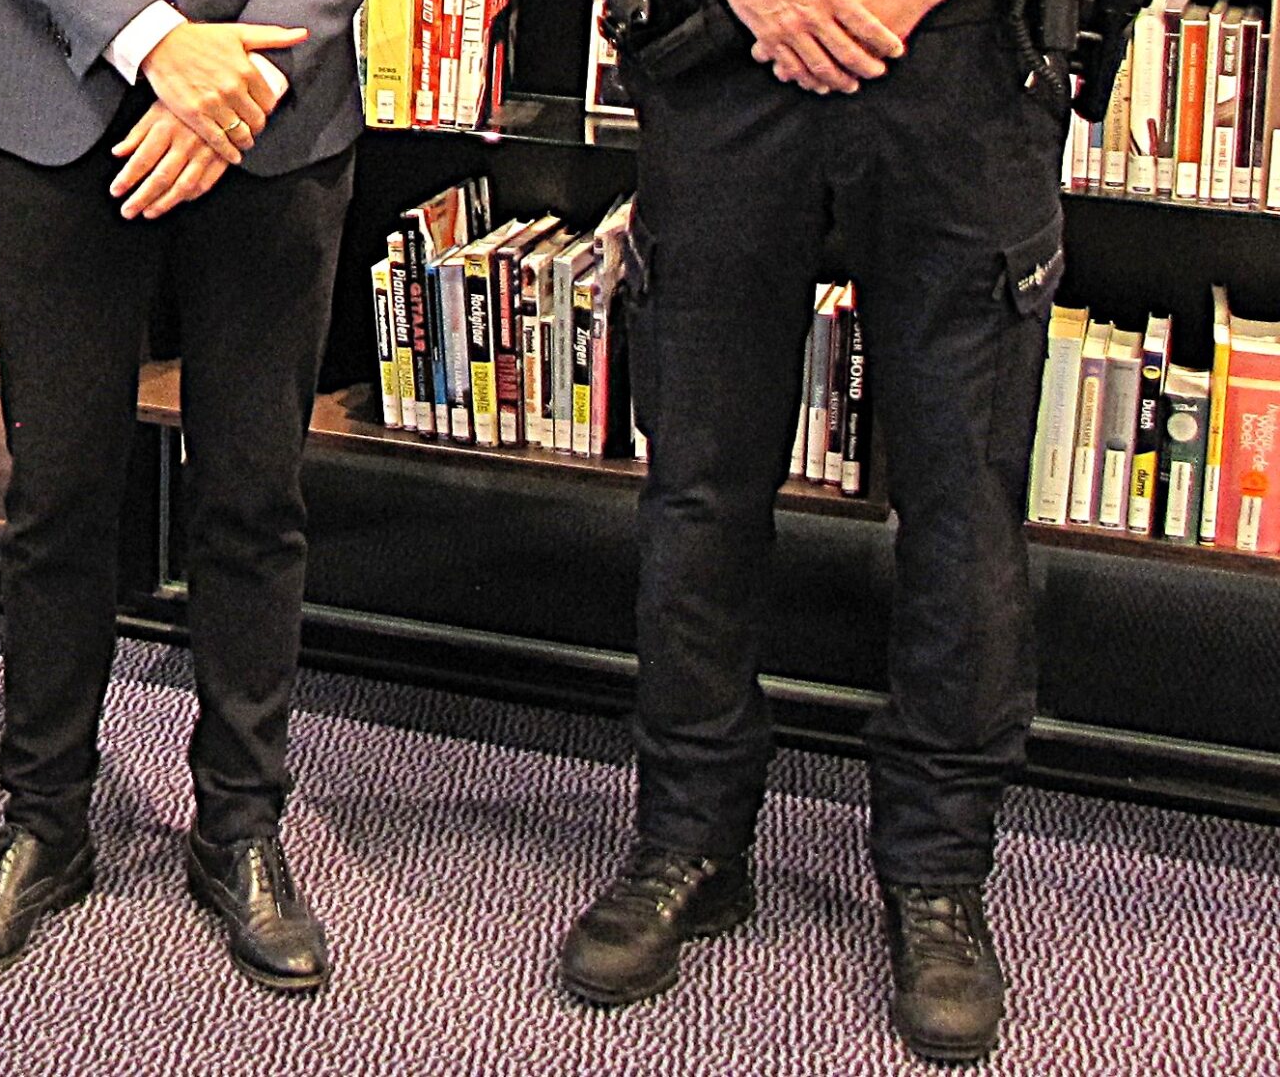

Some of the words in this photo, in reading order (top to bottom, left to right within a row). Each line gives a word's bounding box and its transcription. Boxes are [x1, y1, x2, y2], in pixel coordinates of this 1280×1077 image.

[391, 268, 409, 342] Pianospelen
[468, 293, 485, 348] Rockgitaar
[573, 327, 590, 366] Zingen
[849, 354, 864, 399] BOND
[1140, 398, 1155, 429] Dutch
